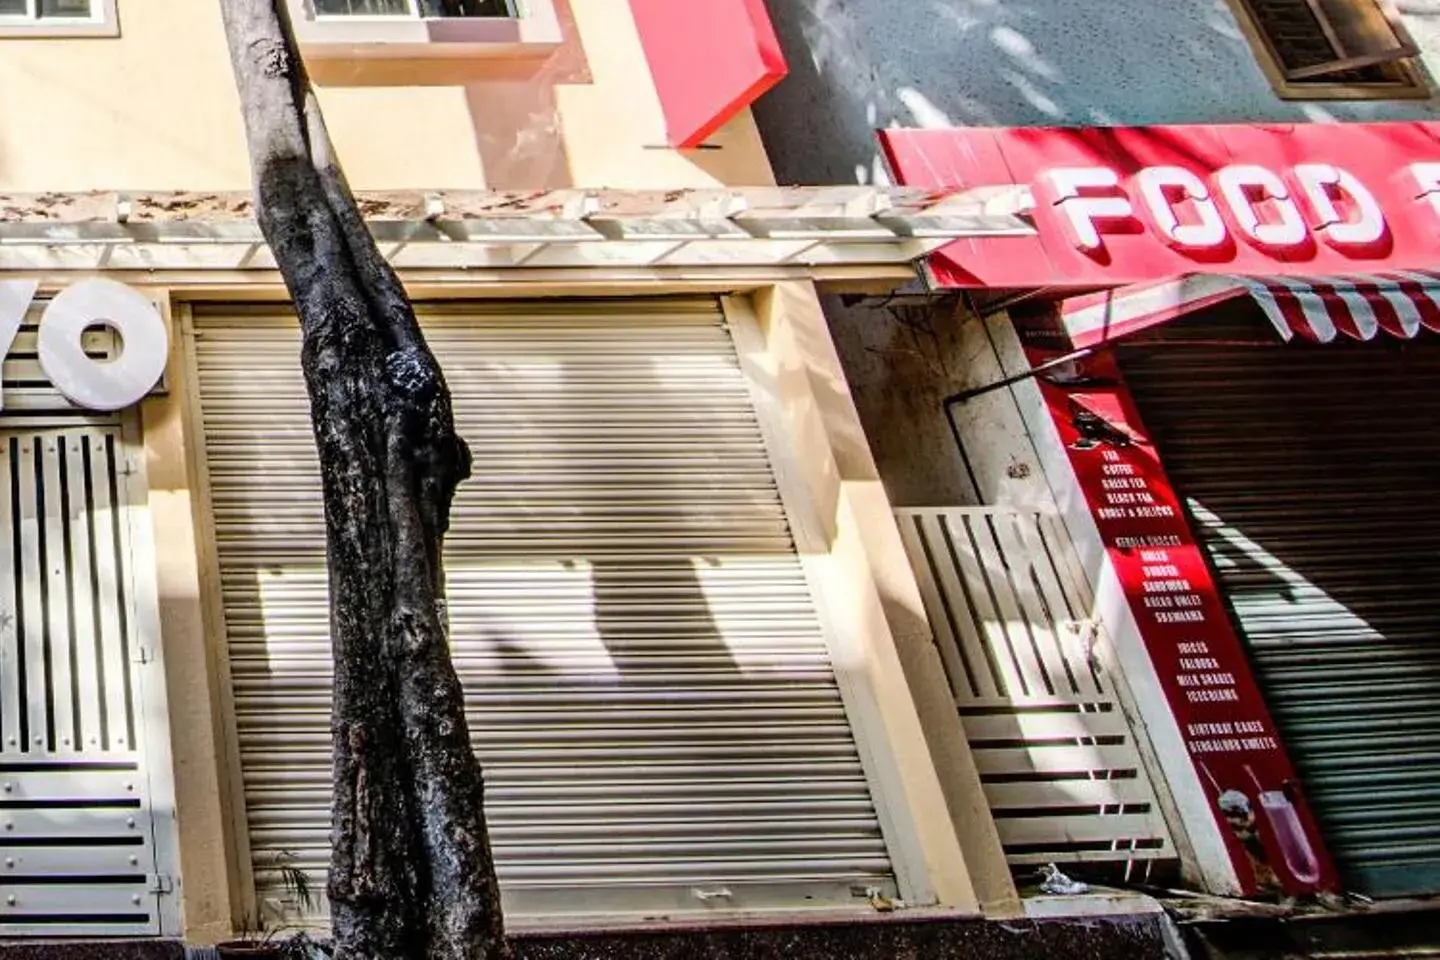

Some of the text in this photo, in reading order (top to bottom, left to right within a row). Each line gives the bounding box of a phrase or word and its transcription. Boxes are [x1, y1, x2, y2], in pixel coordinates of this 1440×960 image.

[1038, 162, 1394, 262] FOOD
[1103, 464, 1133, 475] COFFEE
[1176, 675, 1200, 686] MILK
[1188, 721, 1264, 736] BIRTHDAY CAKES
[1242, 737, 1277, 750] SWEETS
